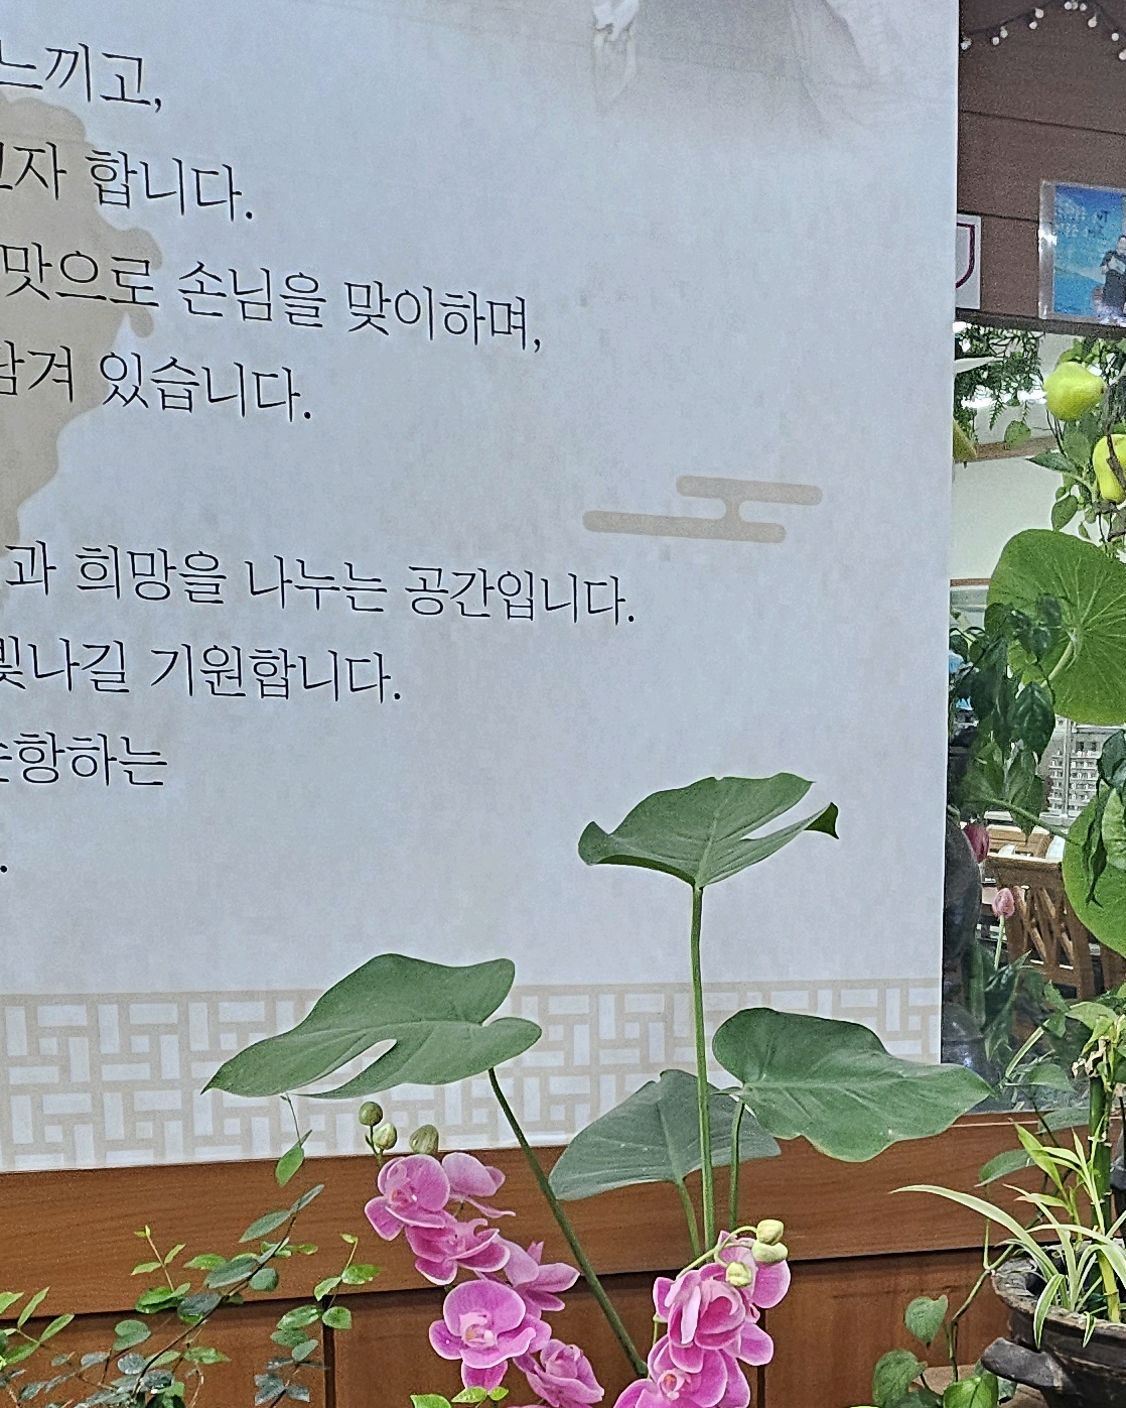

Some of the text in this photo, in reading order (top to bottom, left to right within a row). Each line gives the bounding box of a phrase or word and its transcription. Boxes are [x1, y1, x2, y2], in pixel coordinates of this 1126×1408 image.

[0, 40, 161, 113] 느끼고,
[85, 150, 252, 221] 합니다.
[0, 242, 540, 353] 맛으로 손님을 맞이하며,
[100, 352, 310, 422] 있습니다.
[75, 545, 226, 604] 희망을
[245, 555, 387, 612] 나누는
[405, 566, 634, 625] 공간입니다.
[151, 644, 400, 704] 기원합니다.
